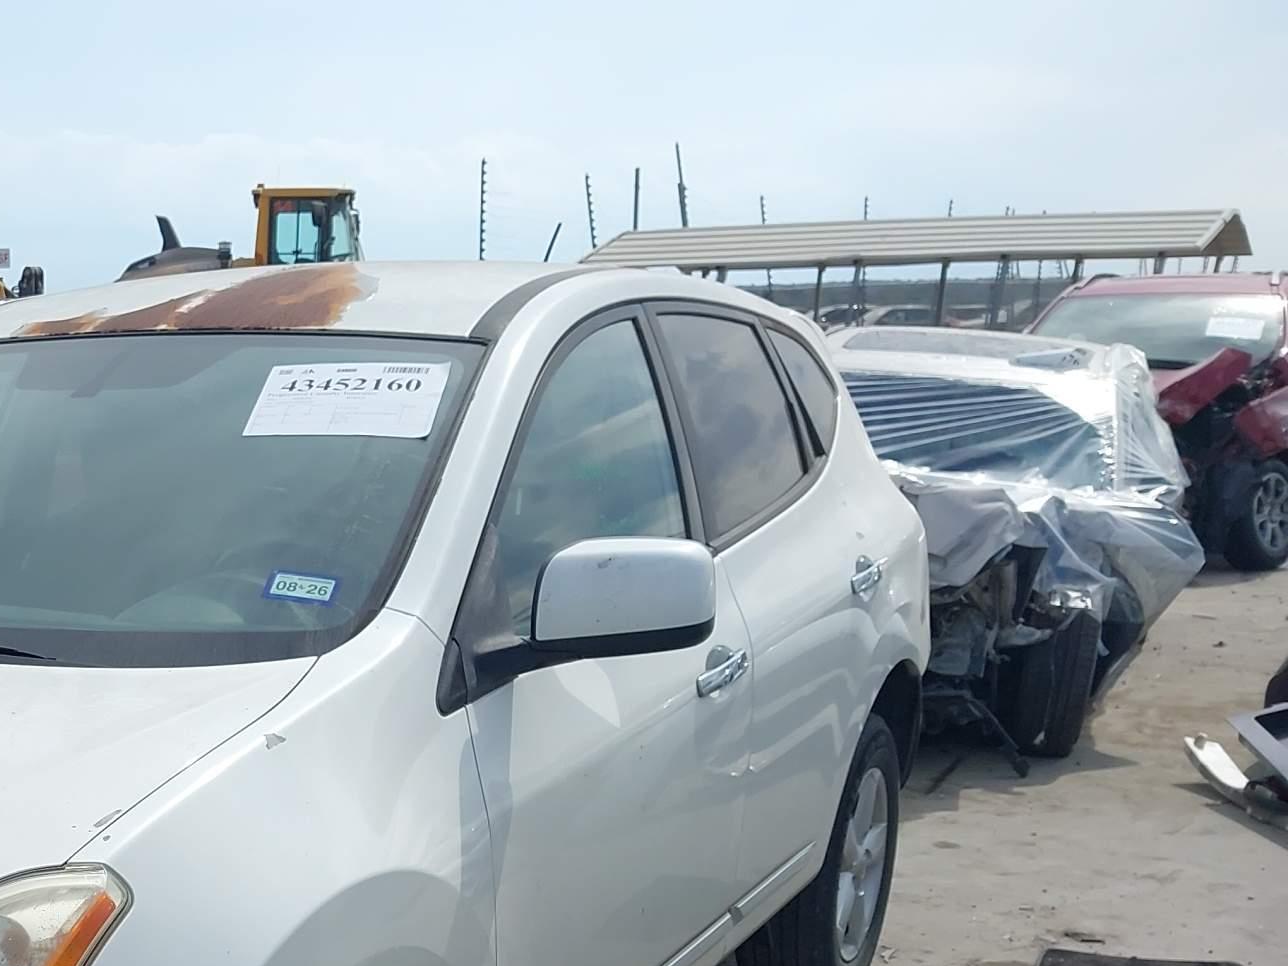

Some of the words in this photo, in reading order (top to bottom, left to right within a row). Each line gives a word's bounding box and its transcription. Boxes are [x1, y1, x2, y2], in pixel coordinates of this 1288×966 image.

[280, 378, 423, 392] 43452160
[275, 580, 298, 592] 08
[305, 583, 329, 597] 26
